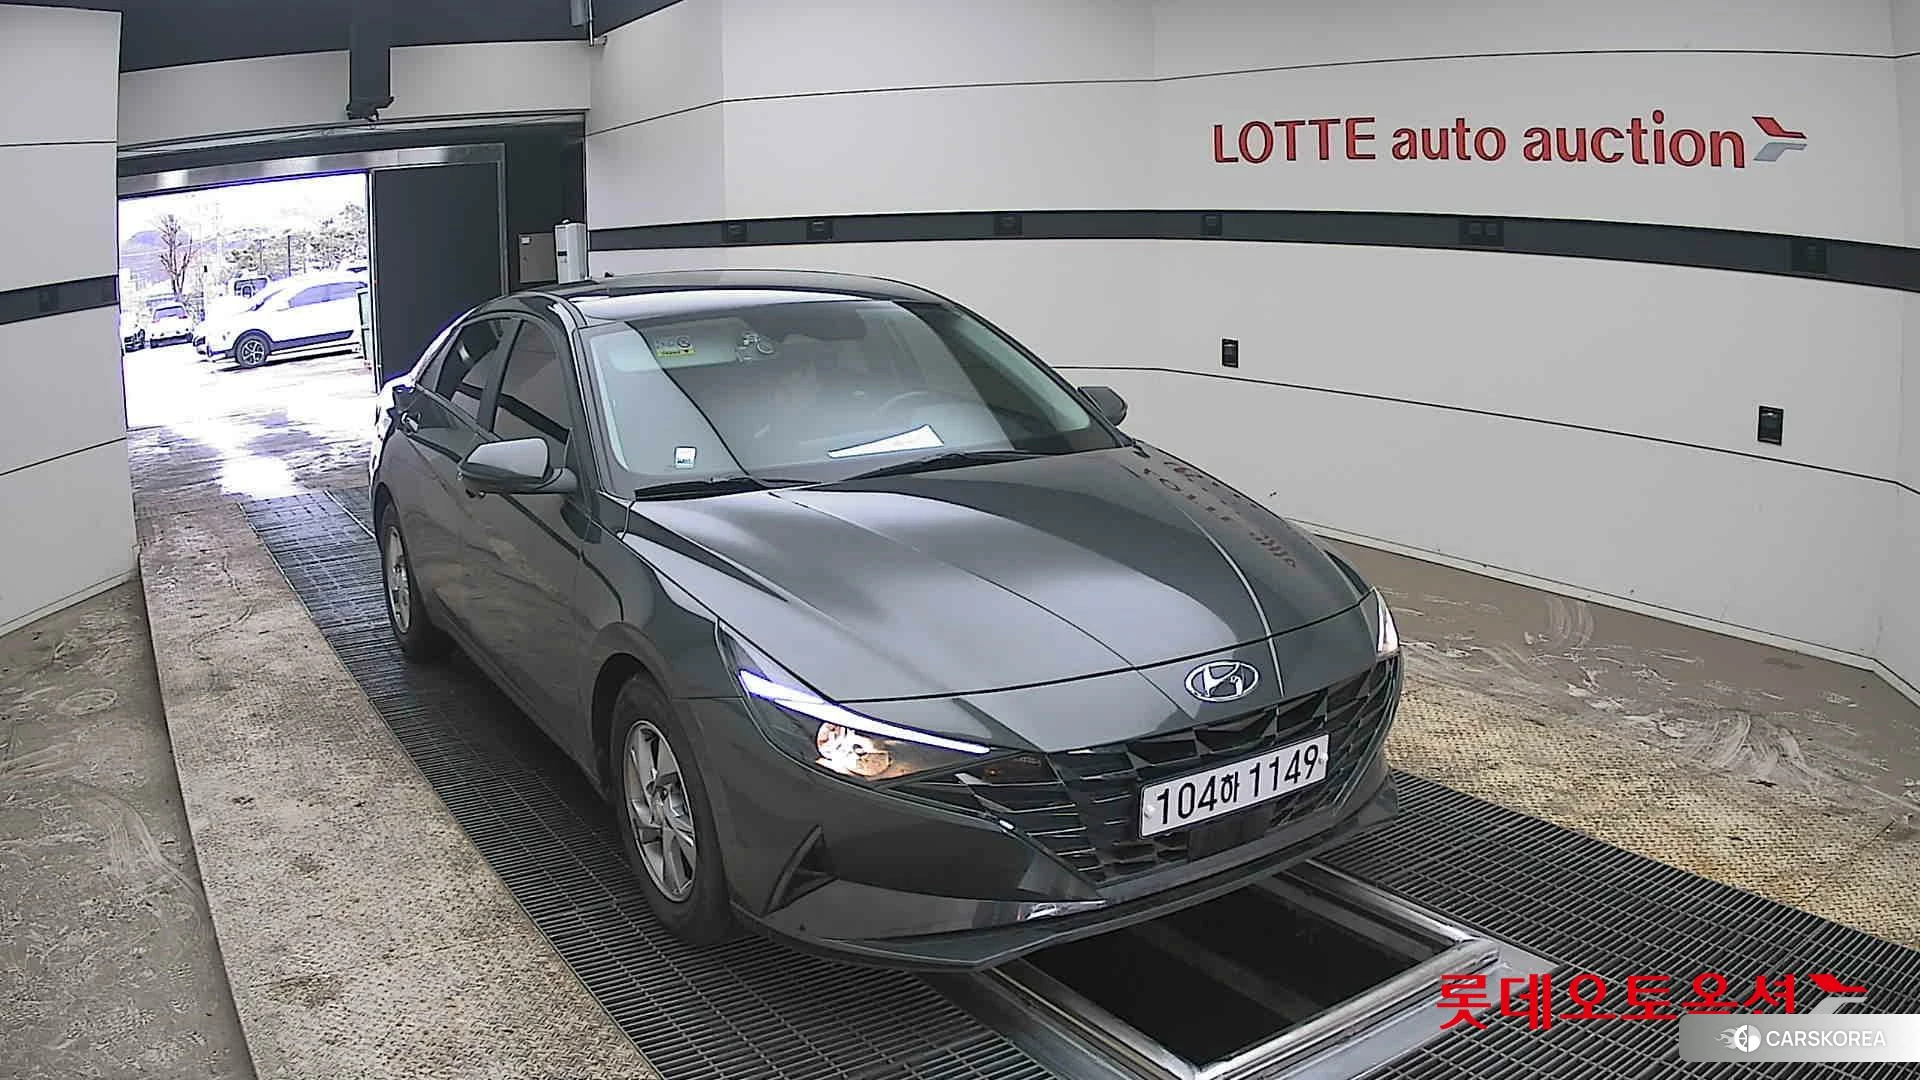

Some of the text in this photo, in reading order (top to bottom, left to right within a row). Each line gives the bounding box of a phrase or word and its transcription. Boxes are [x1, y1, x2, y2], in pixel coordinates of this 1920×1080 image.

[1213, 109, 1746, 169] LOTTE auto auction
[1157, 744, 1319, 824] 104하 1149
